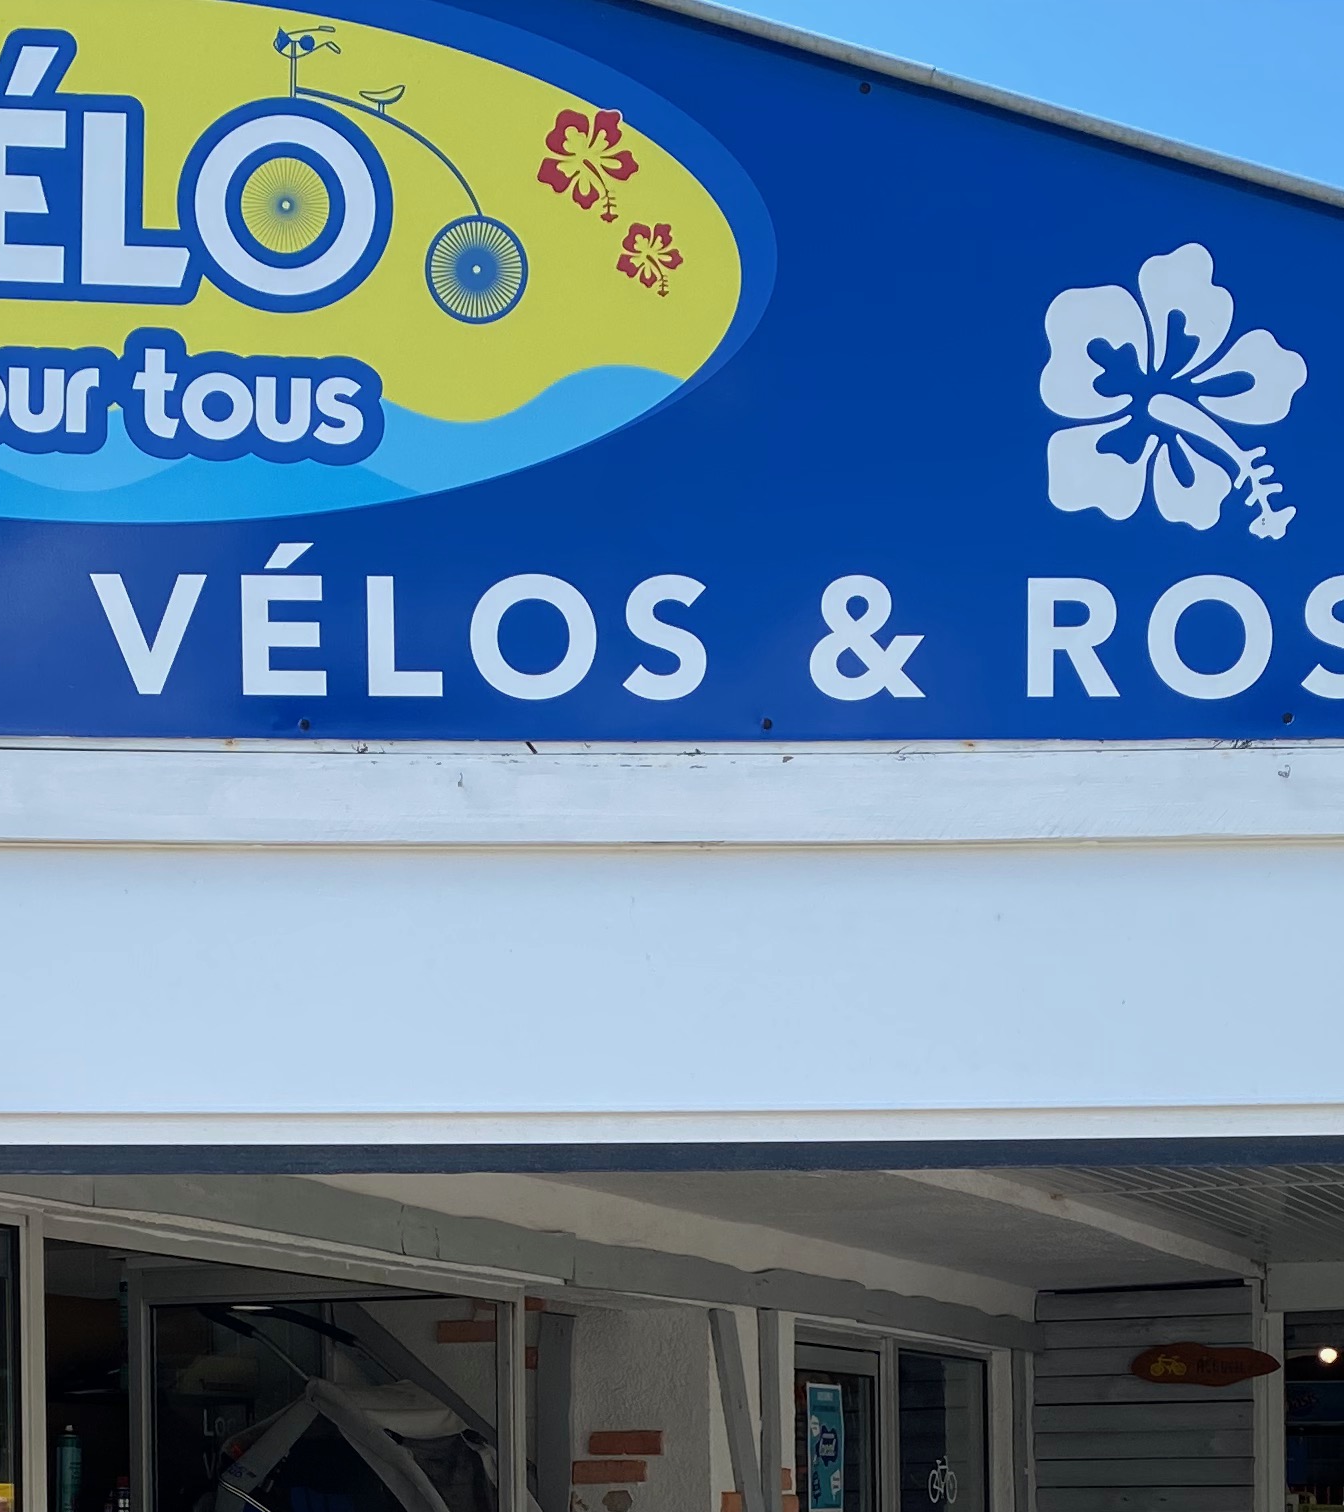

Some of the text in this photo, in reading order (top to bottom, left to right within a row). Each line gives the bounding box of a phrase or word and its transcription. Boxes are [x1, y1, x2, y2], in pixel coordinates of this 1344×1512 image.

[132, 342, 370, 450] tous
[90, 543, 706, 700] VÉLOS
[810, 575, 925, 700] &
